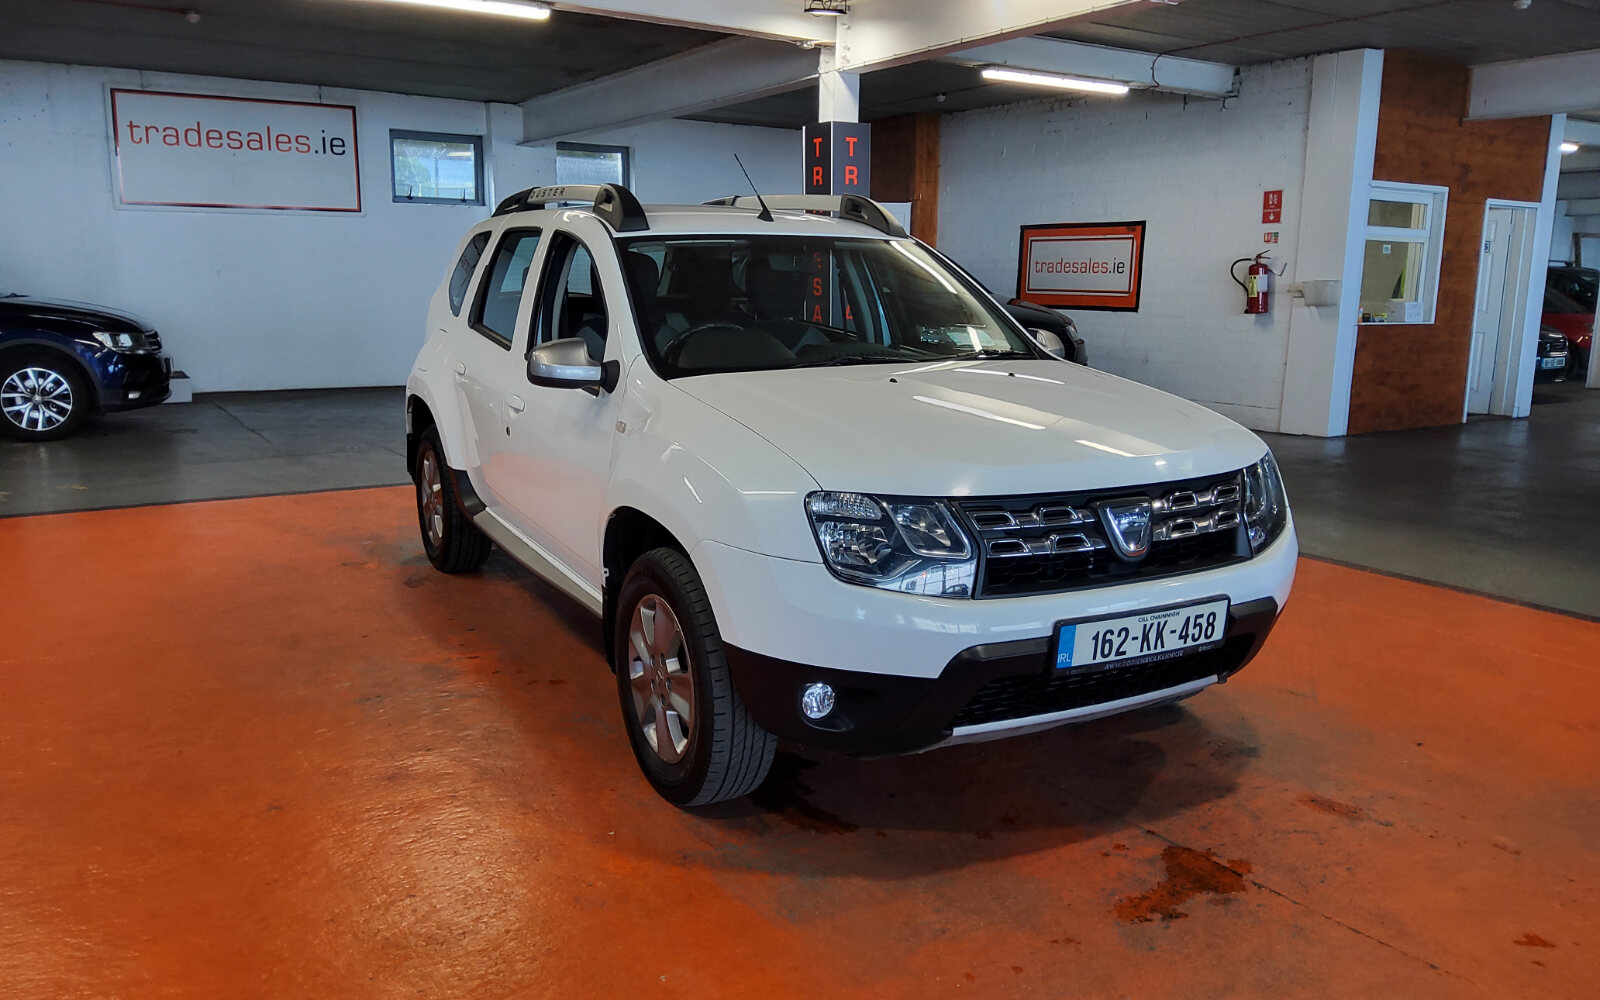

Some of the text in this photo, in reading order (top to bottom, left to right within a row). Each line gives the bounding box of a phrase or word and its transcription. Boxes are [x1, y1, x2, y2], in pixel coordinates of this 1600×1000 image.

[127, 120, 346, 156] tradesales.ie
[530, 187, 566, 199] DUSTER
[1035, 257, 1125, 274] tradesales.ie
[1091, 611, 1217, 661] 162-KK-458
[1057, 652, 1072, 664] IRL
